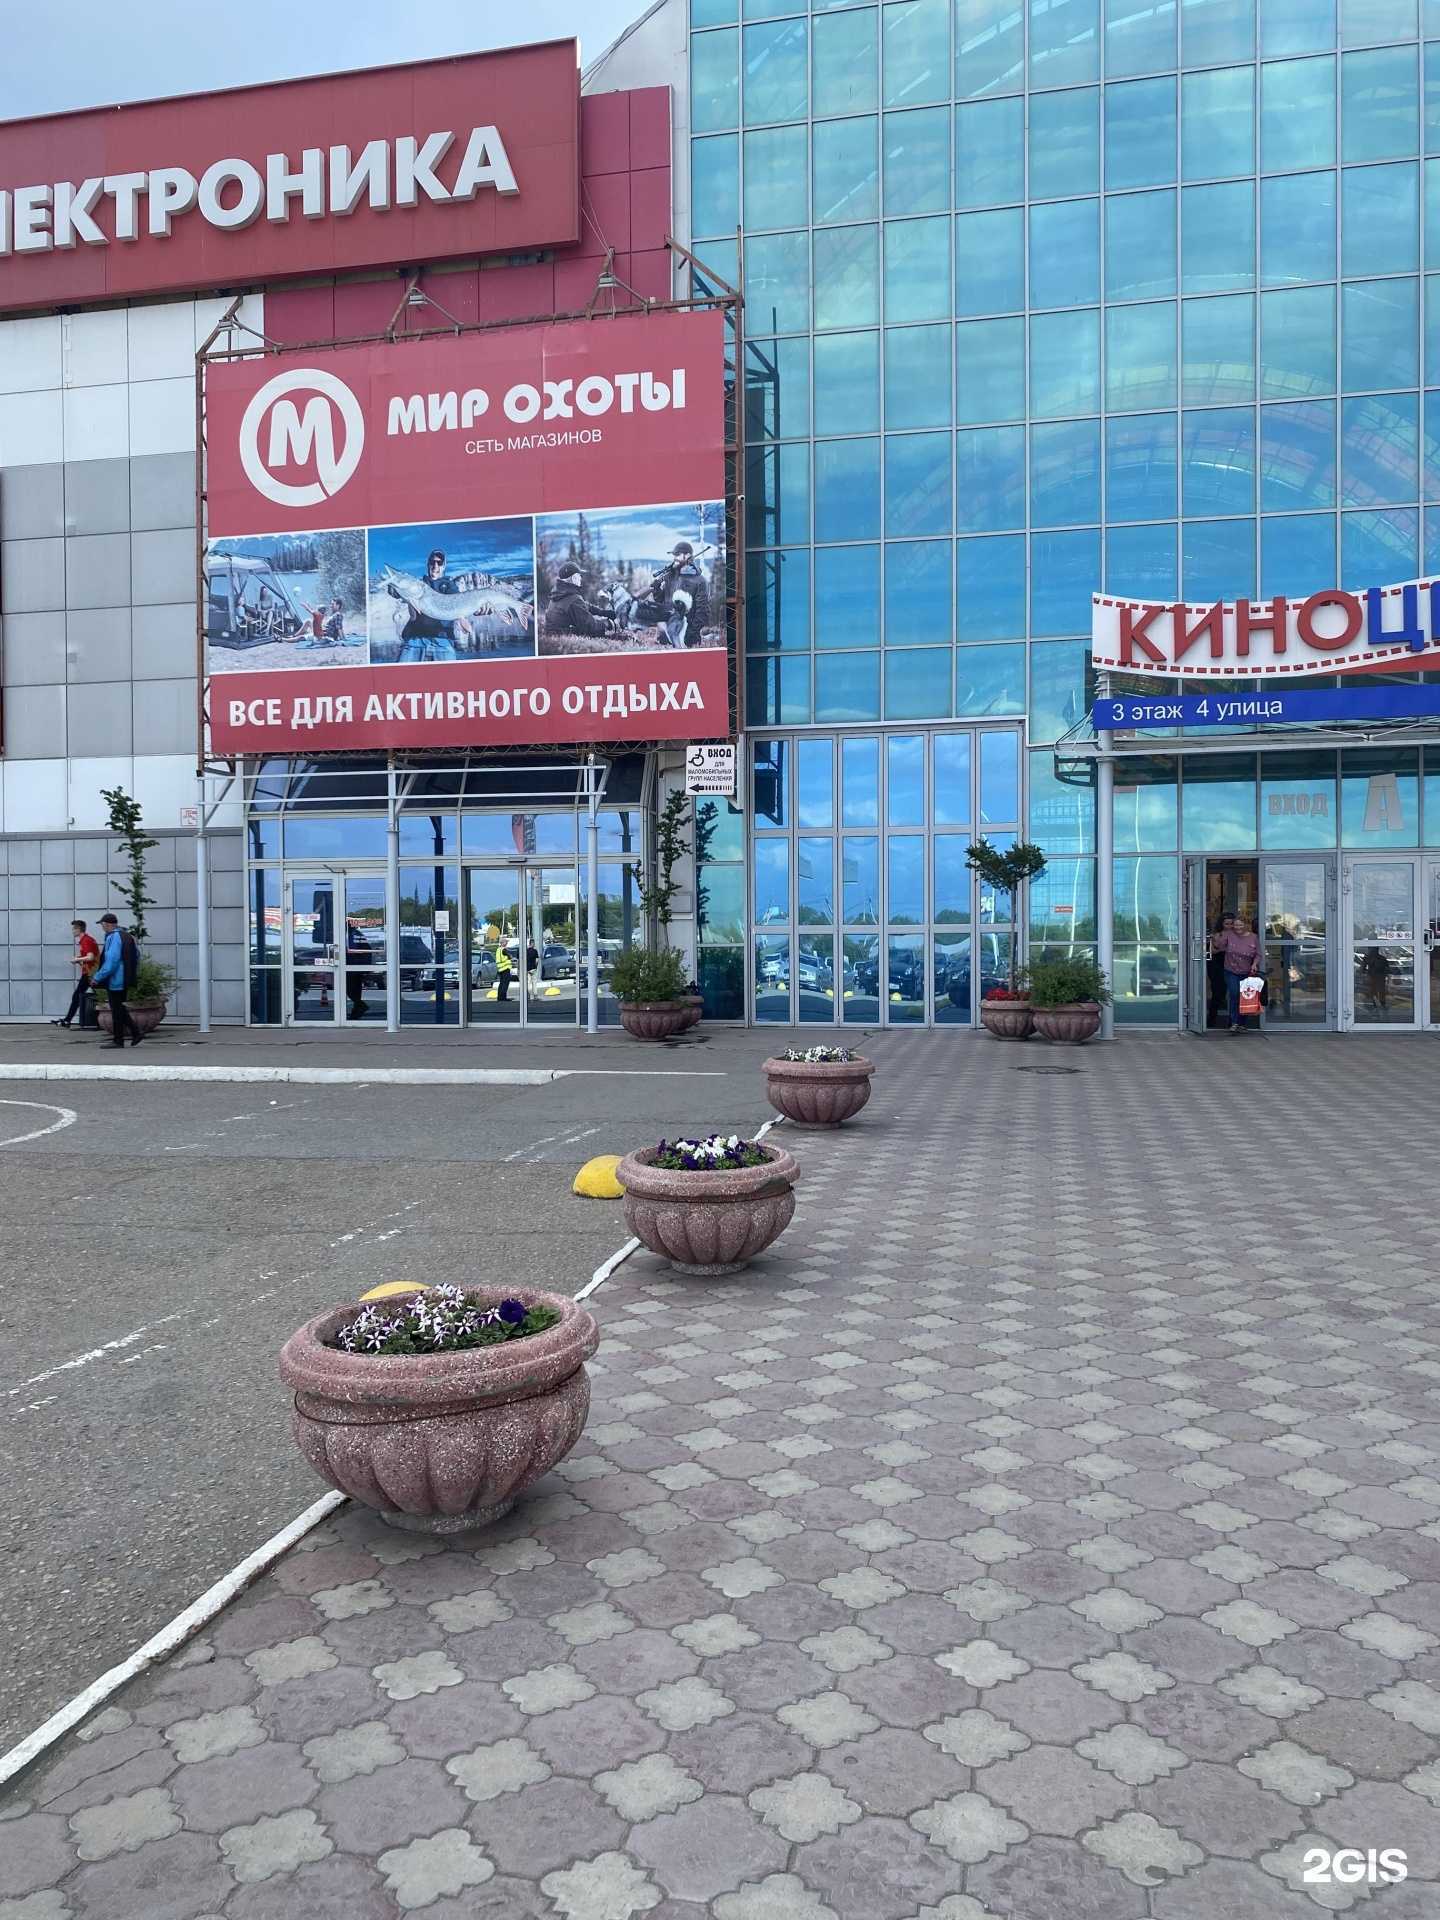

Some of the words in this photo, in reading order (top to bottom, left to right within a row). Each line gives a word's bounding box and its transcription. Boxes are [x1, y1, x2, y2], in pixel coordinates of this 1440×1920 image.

[386, 387, 490, 436] МИР
[503, 368, 687, 424] ОХОТЫ
[465, 438, 504, 456] СЕТЬ
[507, 428, 602, 452] МАГАЗИНОВ
[228, 697, 282, 728] ВСЕ
[290, 696, 353, 730] ДЛЯ
[363, 686, 552, 722] АКТИВНОГО
[562, 680, 705, 718] ОТДЫХА
[1112, 703, 1124, 721] 3
[1131, 704, 1183, 721] этаж
[1195, 699, 1210, 718] 4
[1216, 699, 1284, 721] улица
[707, 748, 732, 758] ВХОД
[1268, 793, 1328, 817] ВХОД
